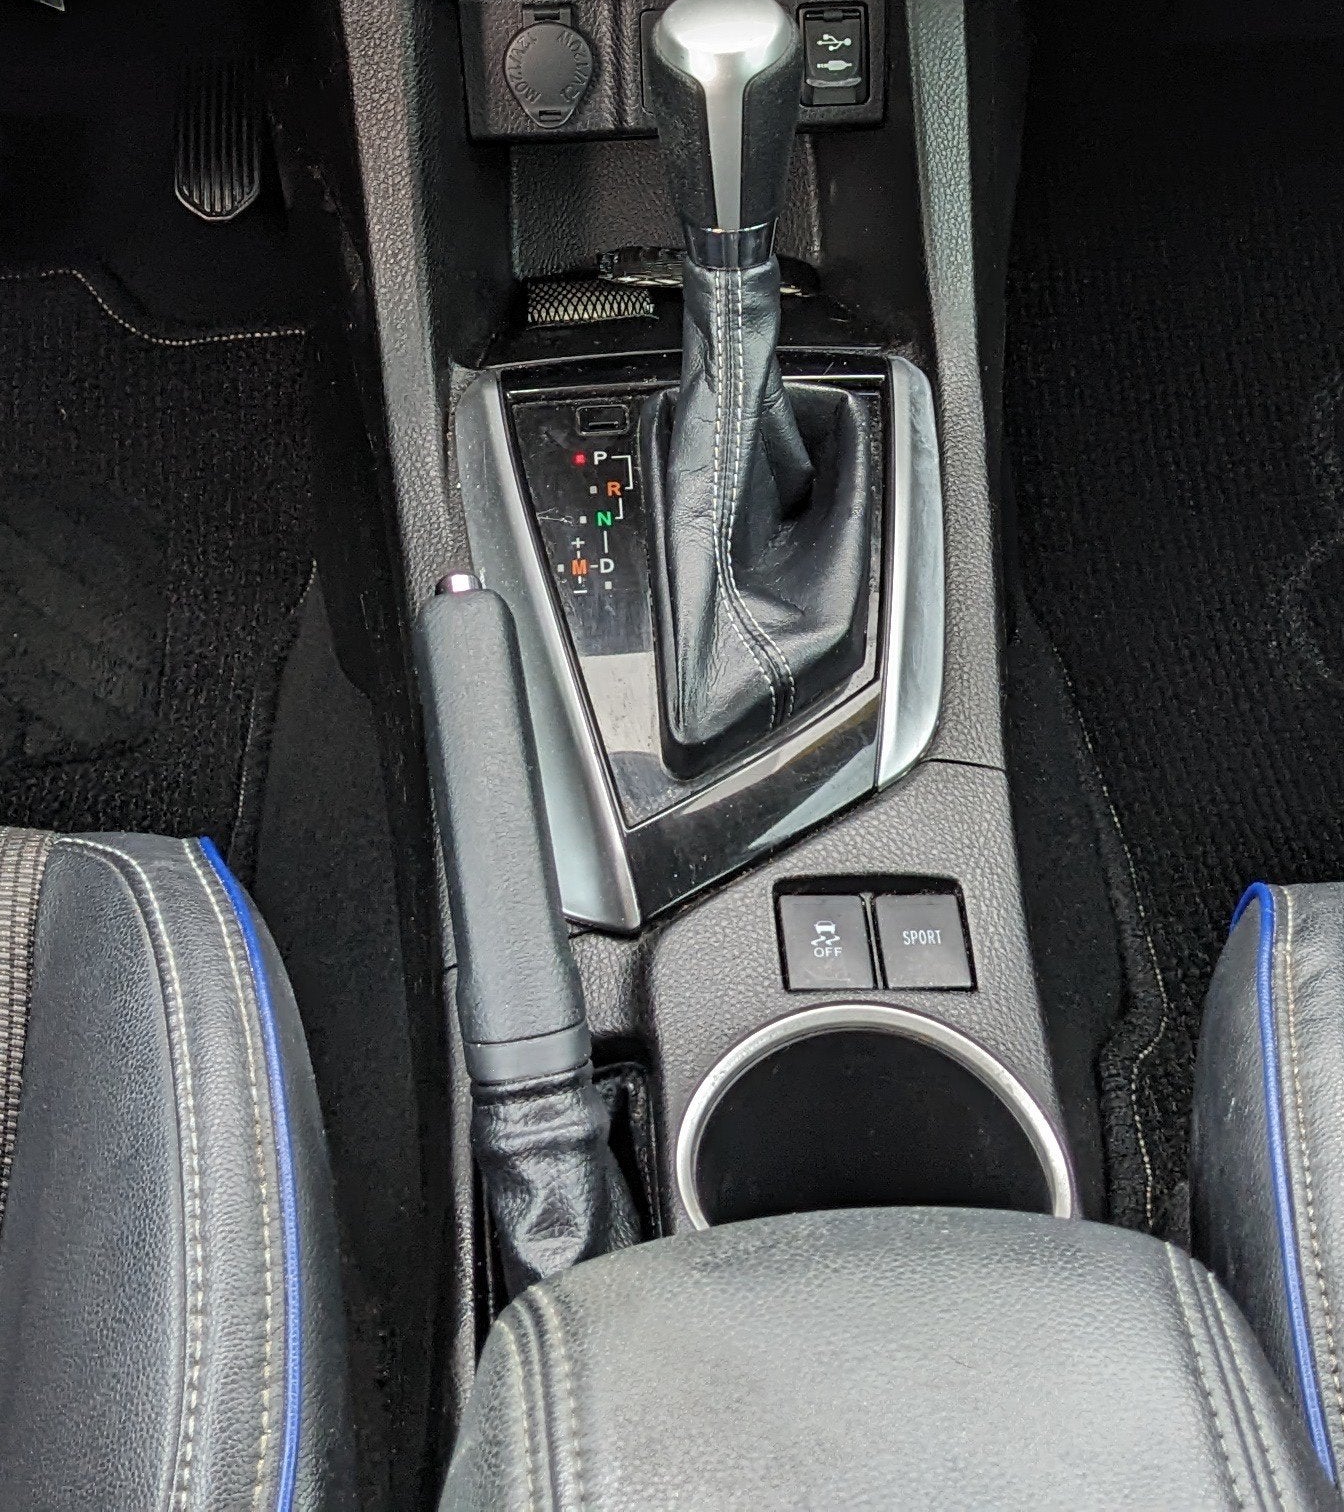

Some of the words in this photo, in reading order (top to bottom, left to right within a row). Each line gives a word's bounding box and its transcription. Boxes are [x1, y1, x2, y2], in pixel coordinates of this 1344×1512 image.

[594, 451, 607, 465] P
[607, 481, 622, 497] R
[597, 511, 612, 527] N
[572, 559, 587, 575] M
[599, 558, 615, 574] D
[902, 929, 942, 945] SPORT
[813, 947, 843, 958] OFF
